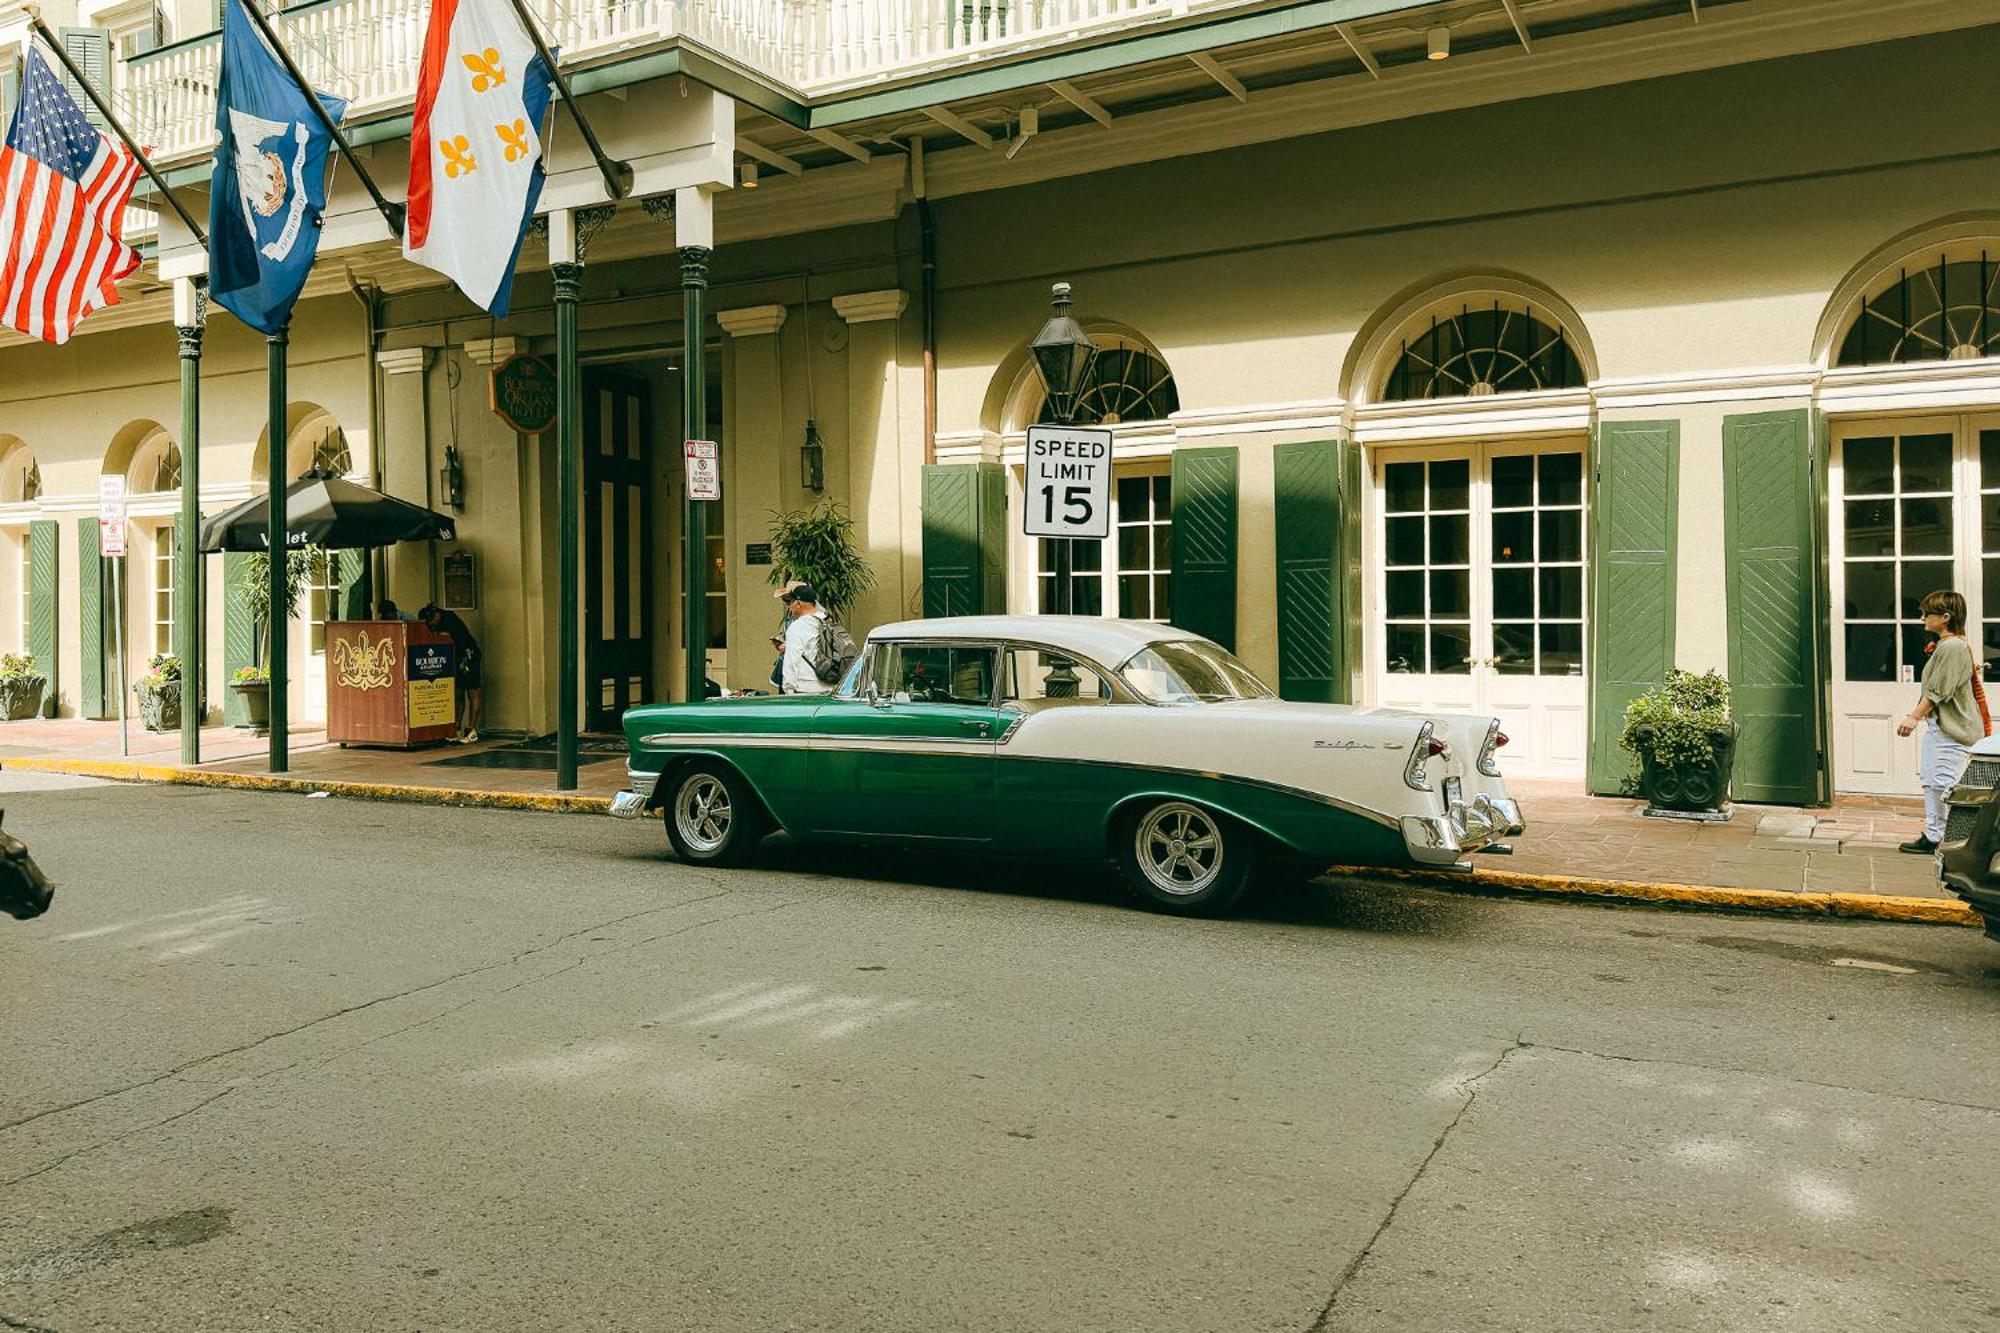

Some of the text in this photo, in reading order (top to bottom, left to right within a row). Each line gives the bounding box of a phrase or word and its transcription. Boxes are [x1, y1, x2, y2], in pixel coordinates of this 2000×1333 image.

[1034, 439, 1105, 458] SPEED
[1041, 462, 1096, 480] LIMIT
[1041, 484, 1093, 525] 15
[260, 531, 308, 546] Vlet
